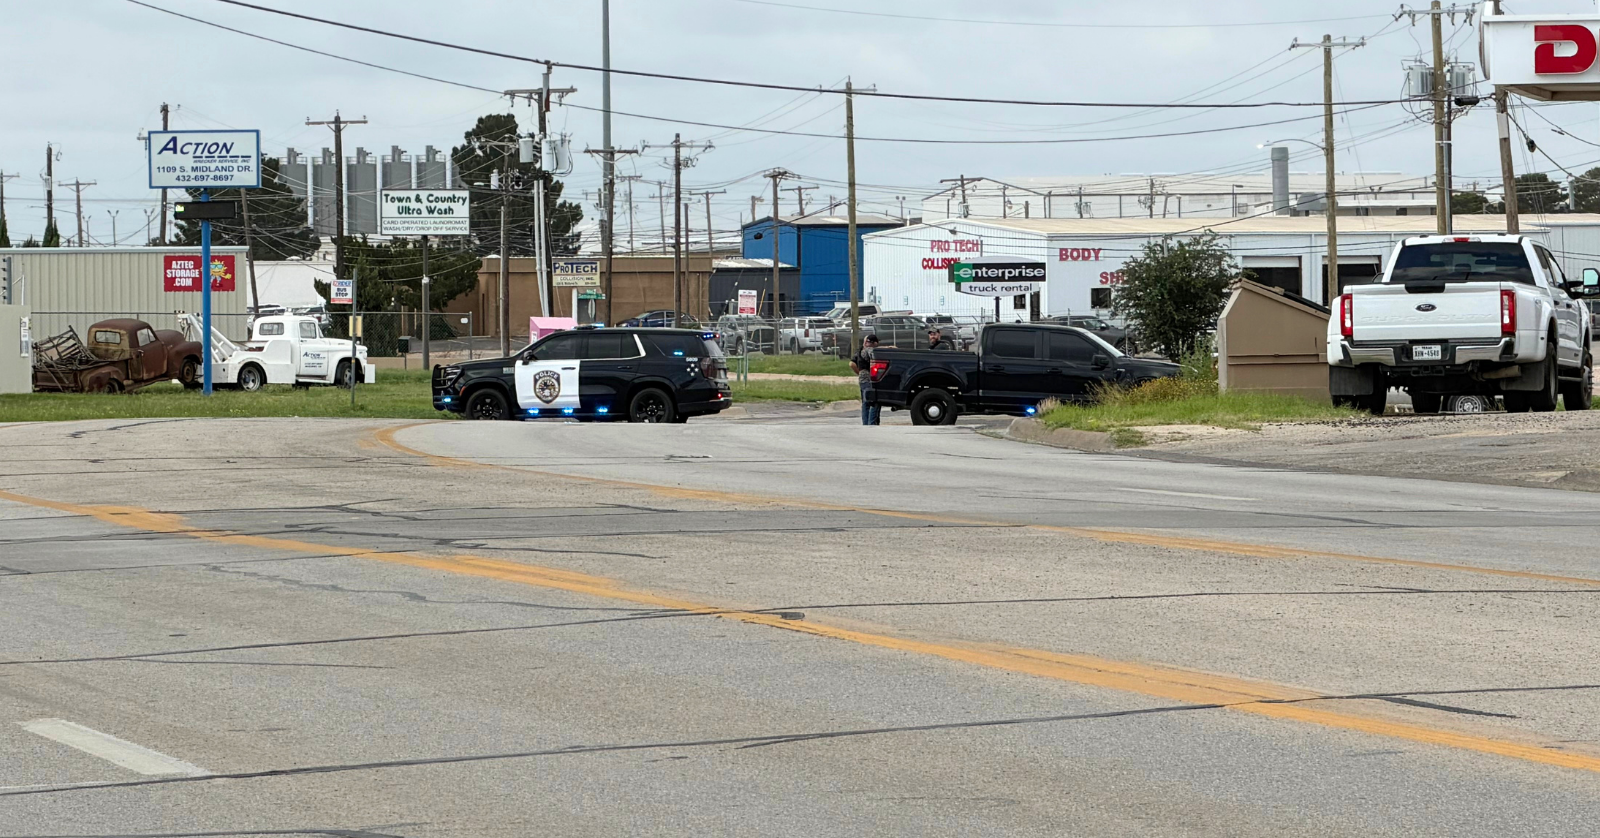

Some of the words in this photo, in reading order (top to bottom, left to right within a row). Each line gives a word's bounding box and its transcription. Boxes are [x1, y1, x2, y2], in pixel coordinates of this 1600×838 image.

[1534, 24, 1600, 75] D
[157, 136, 234, 155] ACTION
[384, 194, 411, 203] Town
[415, 194, 423, 204] &
[426, 194, 467, 206] Country
[397, 205, 422, 215] Ultra
[425, 205, 454, 215] Wash
[930, 240, 950, 252] PRO
[952, 240, 979, 252] TECH
[1059, 248, 1102, 261] BODY
[172, 261, 194, 269] AZTEC
[166, 269, 200, 278] STORAGE
[960, 265, 1045, 280] enterprise
[173, 278, 193, 286] .COM
[969, 283, 997, 292] truck
[1001, 283, 1032, 292] rental
[535, 371, 559, 380] POLICE
